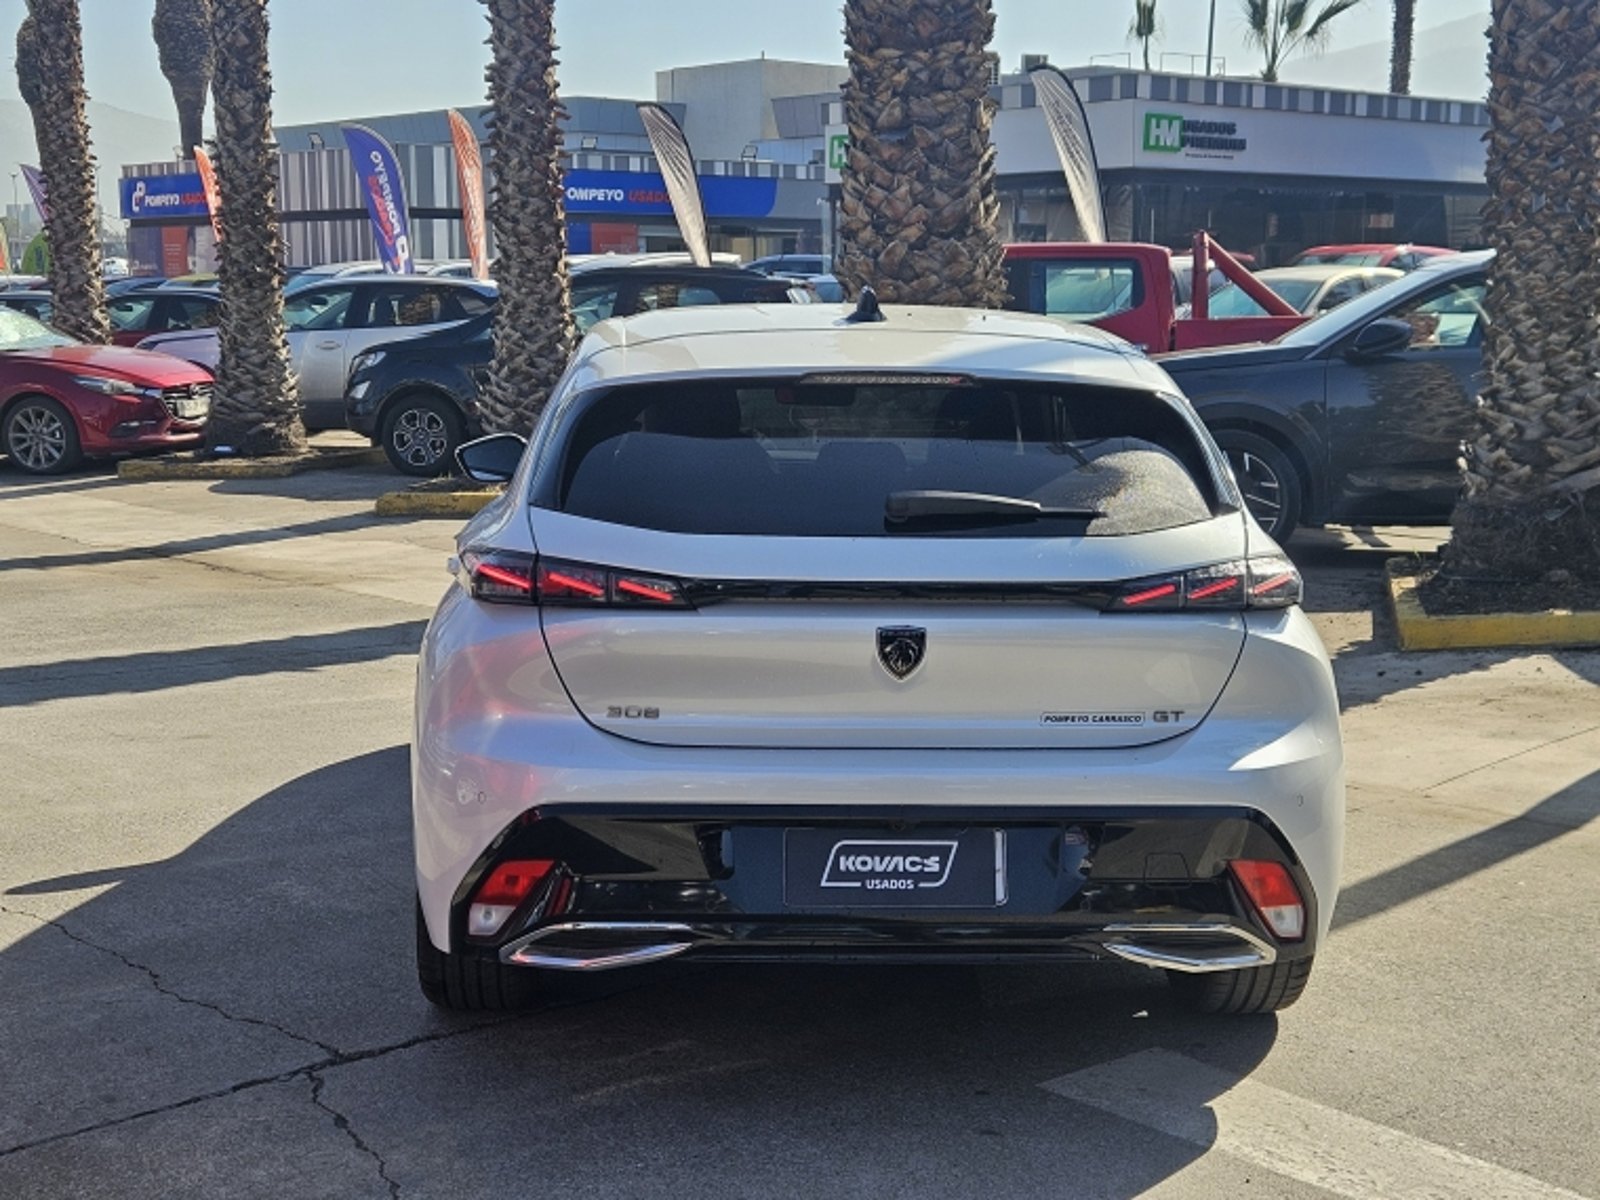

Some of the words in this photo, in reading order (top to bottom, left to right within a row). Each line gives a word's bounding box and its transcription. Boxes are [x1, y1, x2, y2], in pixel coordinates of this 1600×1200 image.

[1149, 117, 1181, 148] HM
[1183, 120, 1237, 135] USADOS
[1183, 136, 1247, 151] PREMIUM
[144, 193, 180, 207] POMPEYO
[565, 187, 624, 201] OMPEYO
[607, 705, 660, 719] 308
[1043, 715, 1089, 723] POMPEYO
[1092, 715, 1142, 723] CARRASCO
[1153, 710, 1185, 723] GT
[839, 855, 940, 872] KOVACS
[865, 879, 914, 889] USADOS
